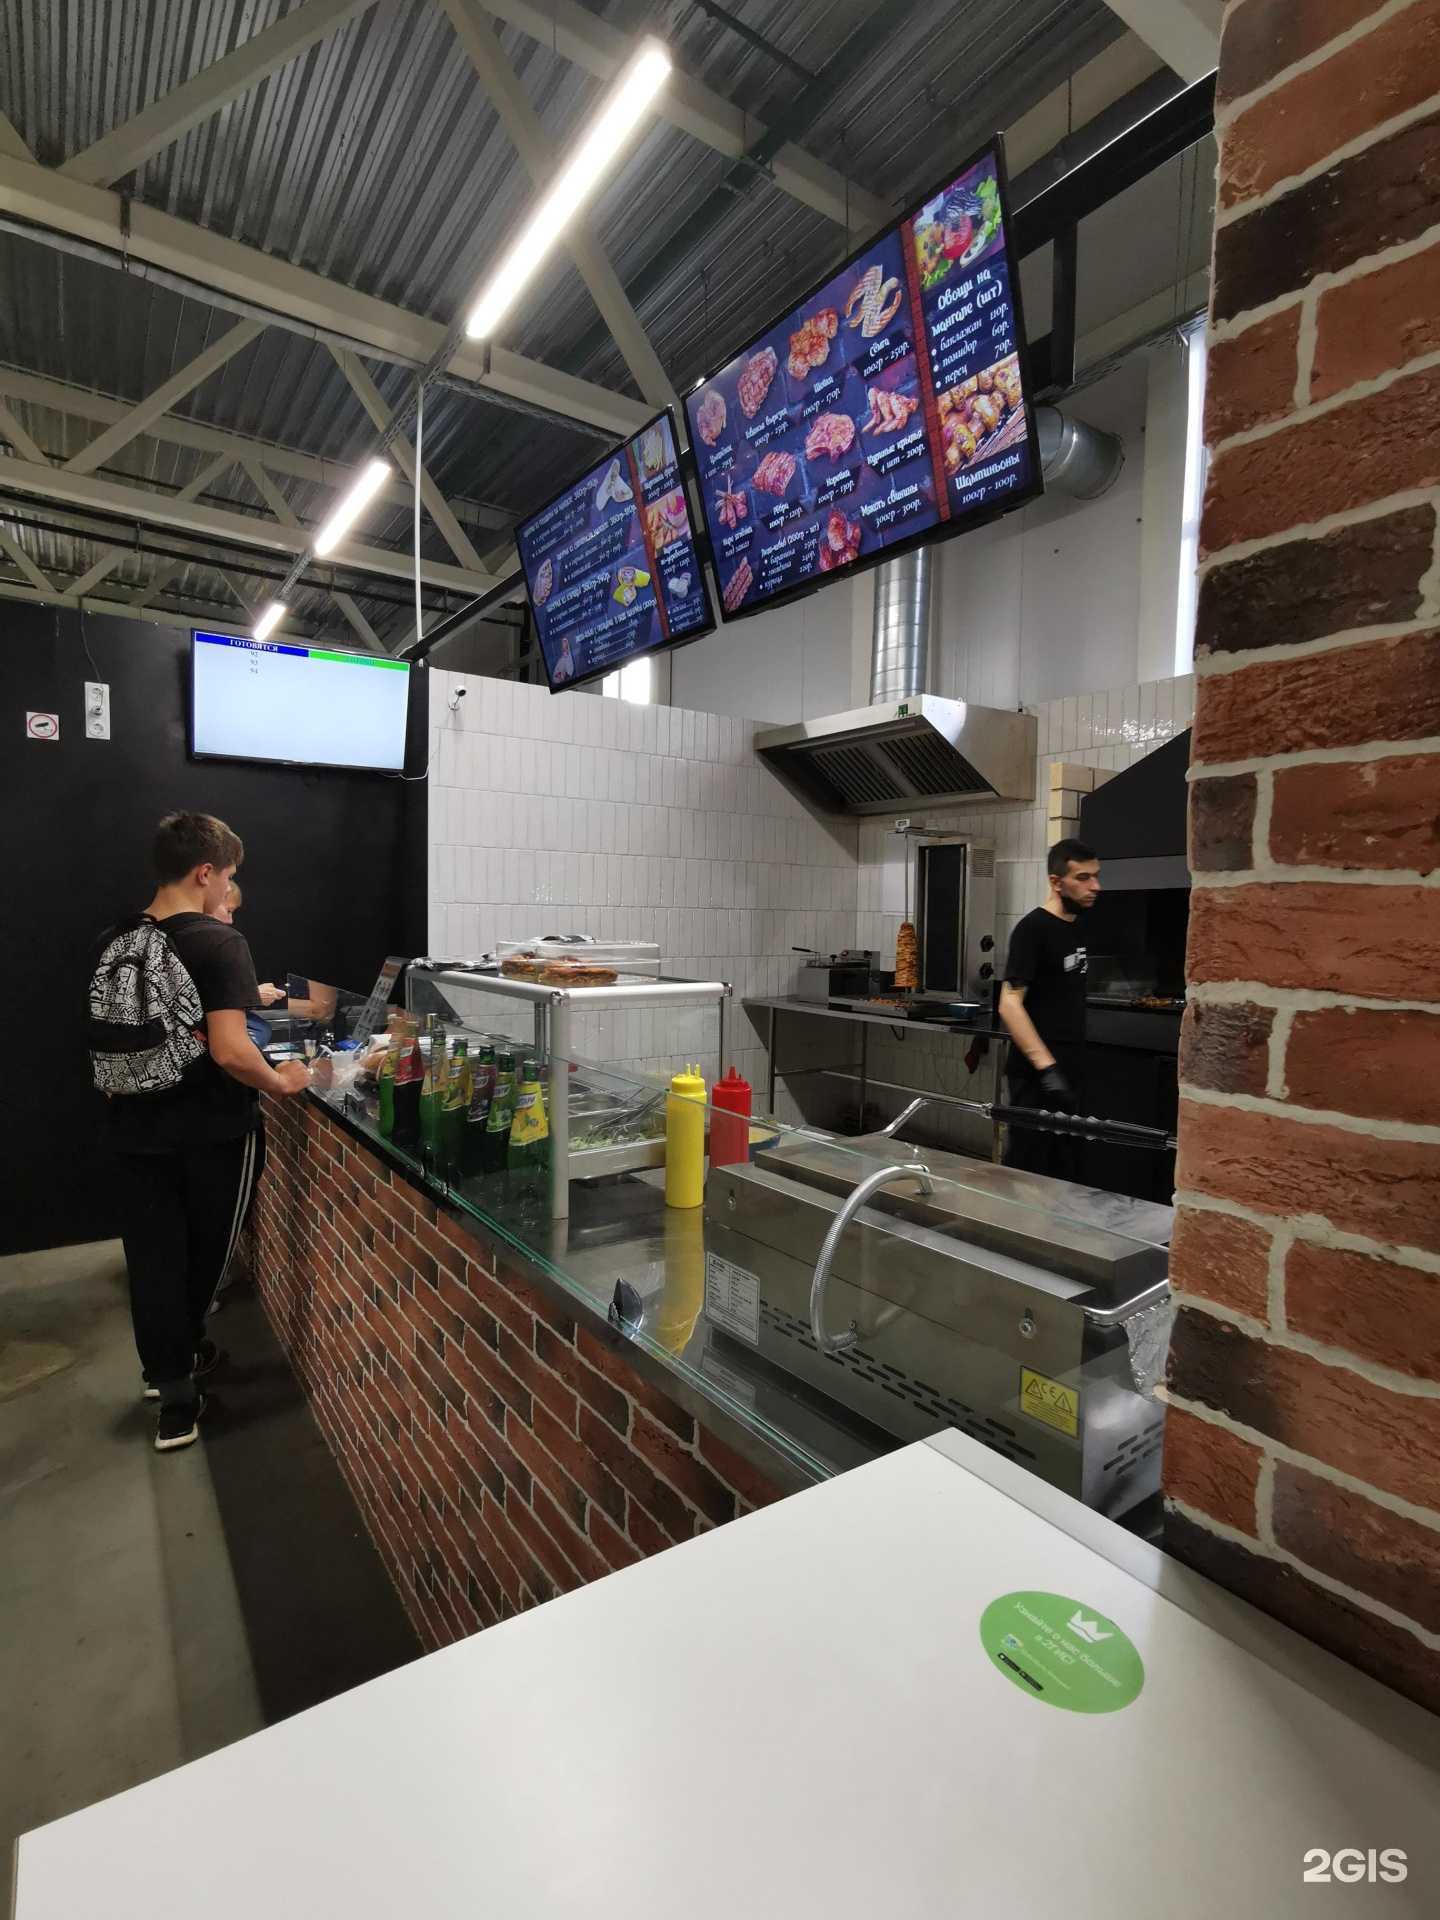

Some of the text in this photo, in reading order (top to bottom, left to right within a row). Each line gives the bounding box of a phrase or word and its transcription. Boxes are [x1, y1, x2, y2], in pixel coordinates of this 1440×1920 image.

[931, 279, 1002, 335] мангале (шт)
[937, 269, 991, 309] Овощи на
[940, 319, 981, 350] баклажан
[942, 320, 1009, 366] помидор 60р.
[944, 338, 1011, 383] перец 70р.
[955, 454, 1019, 489] Шампиньоны
